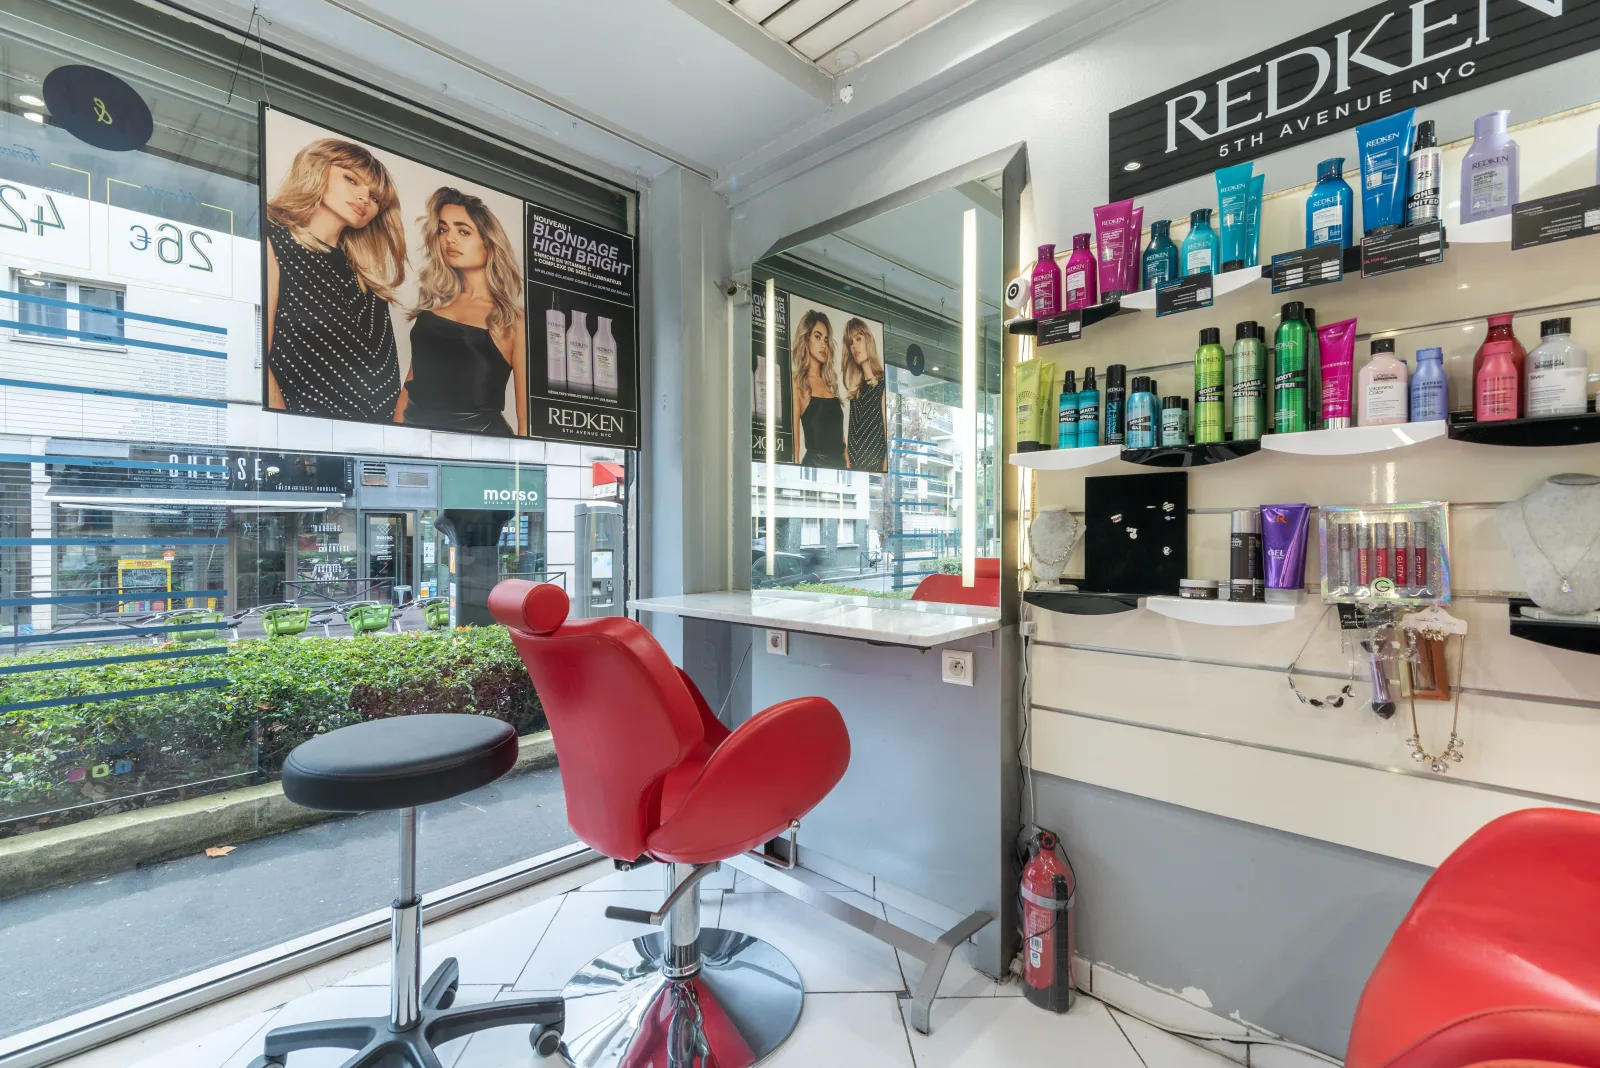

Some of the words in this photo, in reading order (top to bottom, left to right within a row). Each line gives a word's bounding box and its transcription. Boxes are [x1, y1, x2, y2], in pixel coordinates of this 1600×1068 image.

[1219, 134, 1264, 158] 5TH
[1279, 88, 1393, 138] AVENUE
[1412, 61, 1476, 94] NYC
[1366, 131, 1400, 148] REDKEN
[1472, 155, 1509, 170] REDKEN
[1417, 170, 1433, 180] 25
[1220, 183, 1246, 193] REDKEN
[1413, 190, 1434, 200] ONE
[1313, 195, 1342, 208] REDKEN
[1408, 198, 1440, 209] UNITED
[533, 214, 567, 231] NOUVEAU
[1101, 217, 1125, 226] REDKEN
[532, 222, 619, 260] BLONDAGE
[532, 236, 573, 260] HIGH
[575, 250, 631, 276] BRIGHT
[1147, 252, 1169, 262] REDKEN
[538, 259, 567, 271] COMPLEXE
[1275, 340, 1299, 351] EDKEN
[1275, 372, 1293, 382] ROOT
[1199, 387, 1217, 395] ROOT
[1232, 380, 1261, 391] OUCHABLE
[548, 407, 624, 433] REDKEN
[576, 429, 598, 437] AVENUE
[484, 489, 538, 501] morso
[1268, 548, 1286, 557] GEL
[1396, 555, 1404, 578] GLITZY
